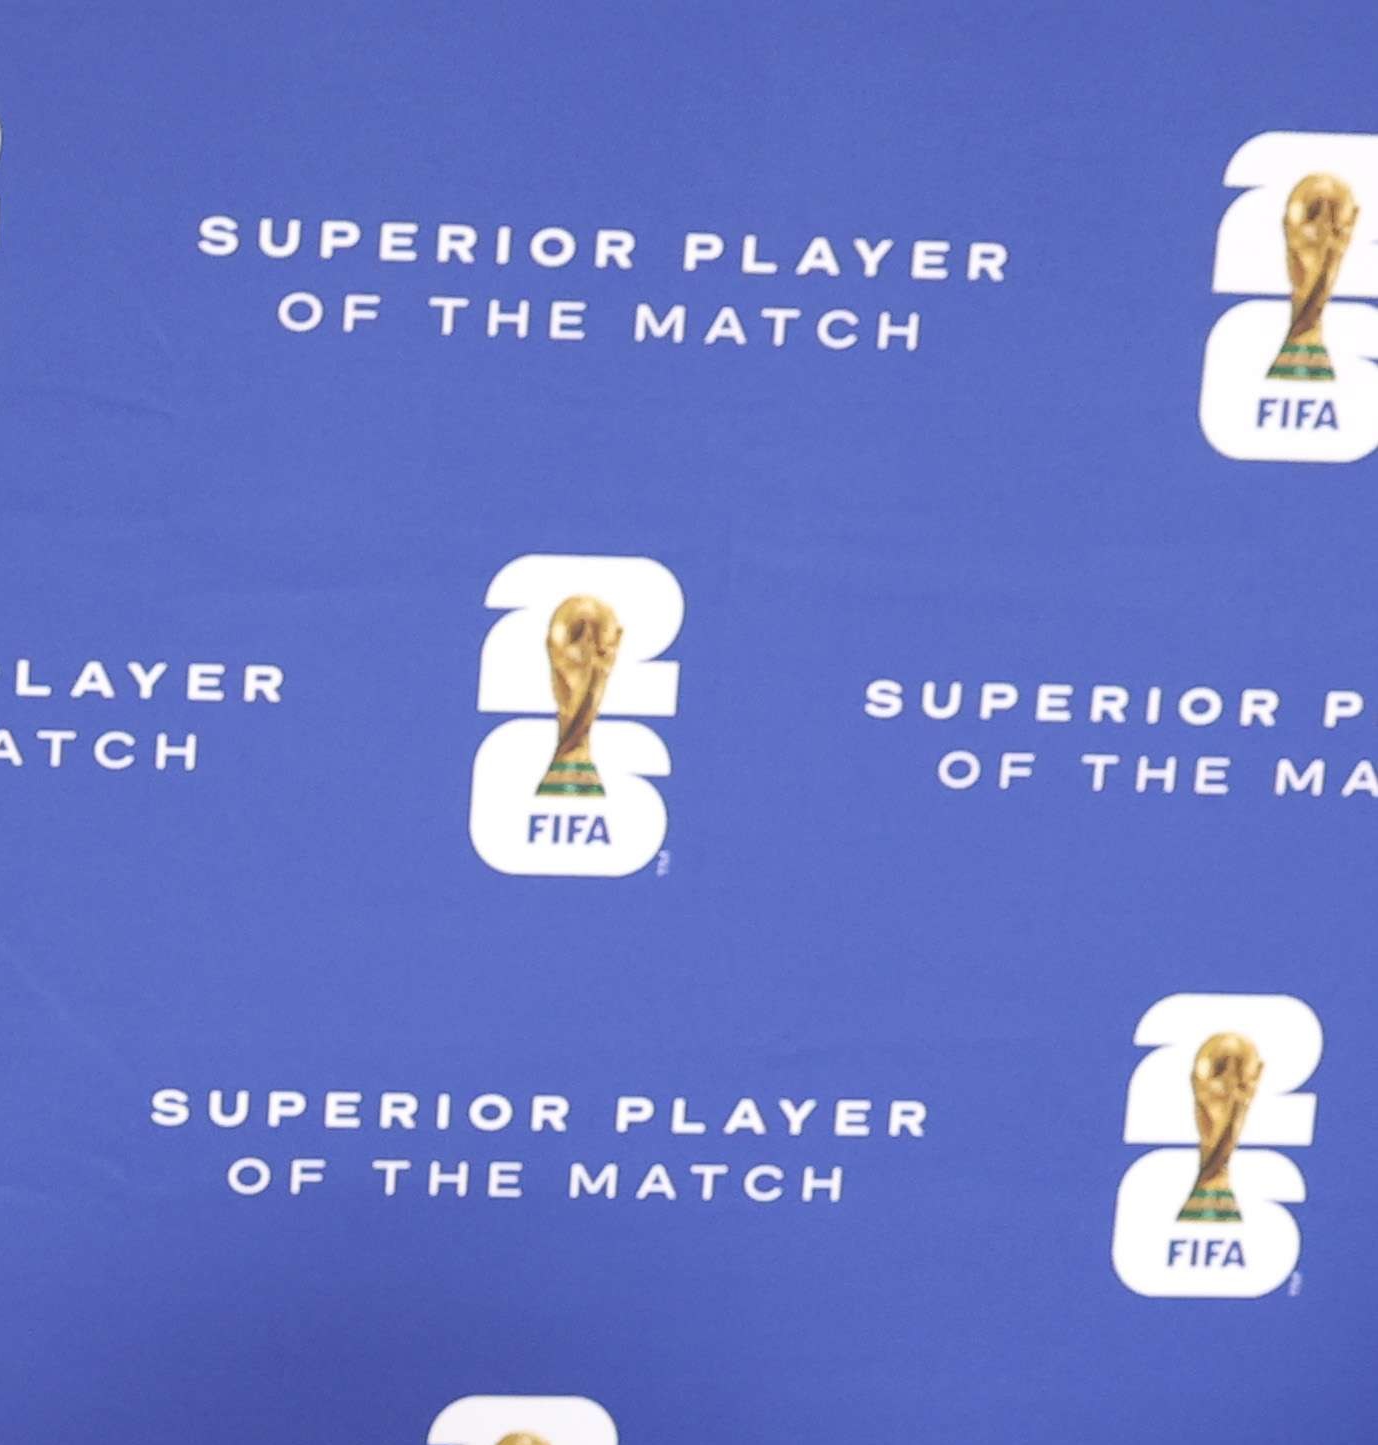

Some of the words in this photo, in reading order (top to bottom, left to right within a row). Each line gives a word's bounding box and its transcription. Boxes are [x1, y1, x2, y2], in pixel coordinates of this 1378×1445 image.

[197, 215, 636, 270] SUPERIOR
[683, 232, 1008, 283] PLAYER
[277, 291, 381, 333] OF
[428, 296, 587, 341] THE
[634, 303, 920, 352] MATCH
[1256, 397, 1339, 431] FIFA
[864, 679, 1280, 728] SUPERIOR
[937, 750, 1037, 790] OF
[1081, 753, 1231, 795] THE
[527, 814, 611, 846] FIFA
[150, 1088, 570, 1132] SUPERIOR
[615, 1096, 927, 1138] PLAYER
[227, 1157, 327, 1196] OF
[371, 1159, 523, 1198] THE
[568, 1162, 843, 1203] MATCH
[1166, 1239, 1247, 1270] FIFA
